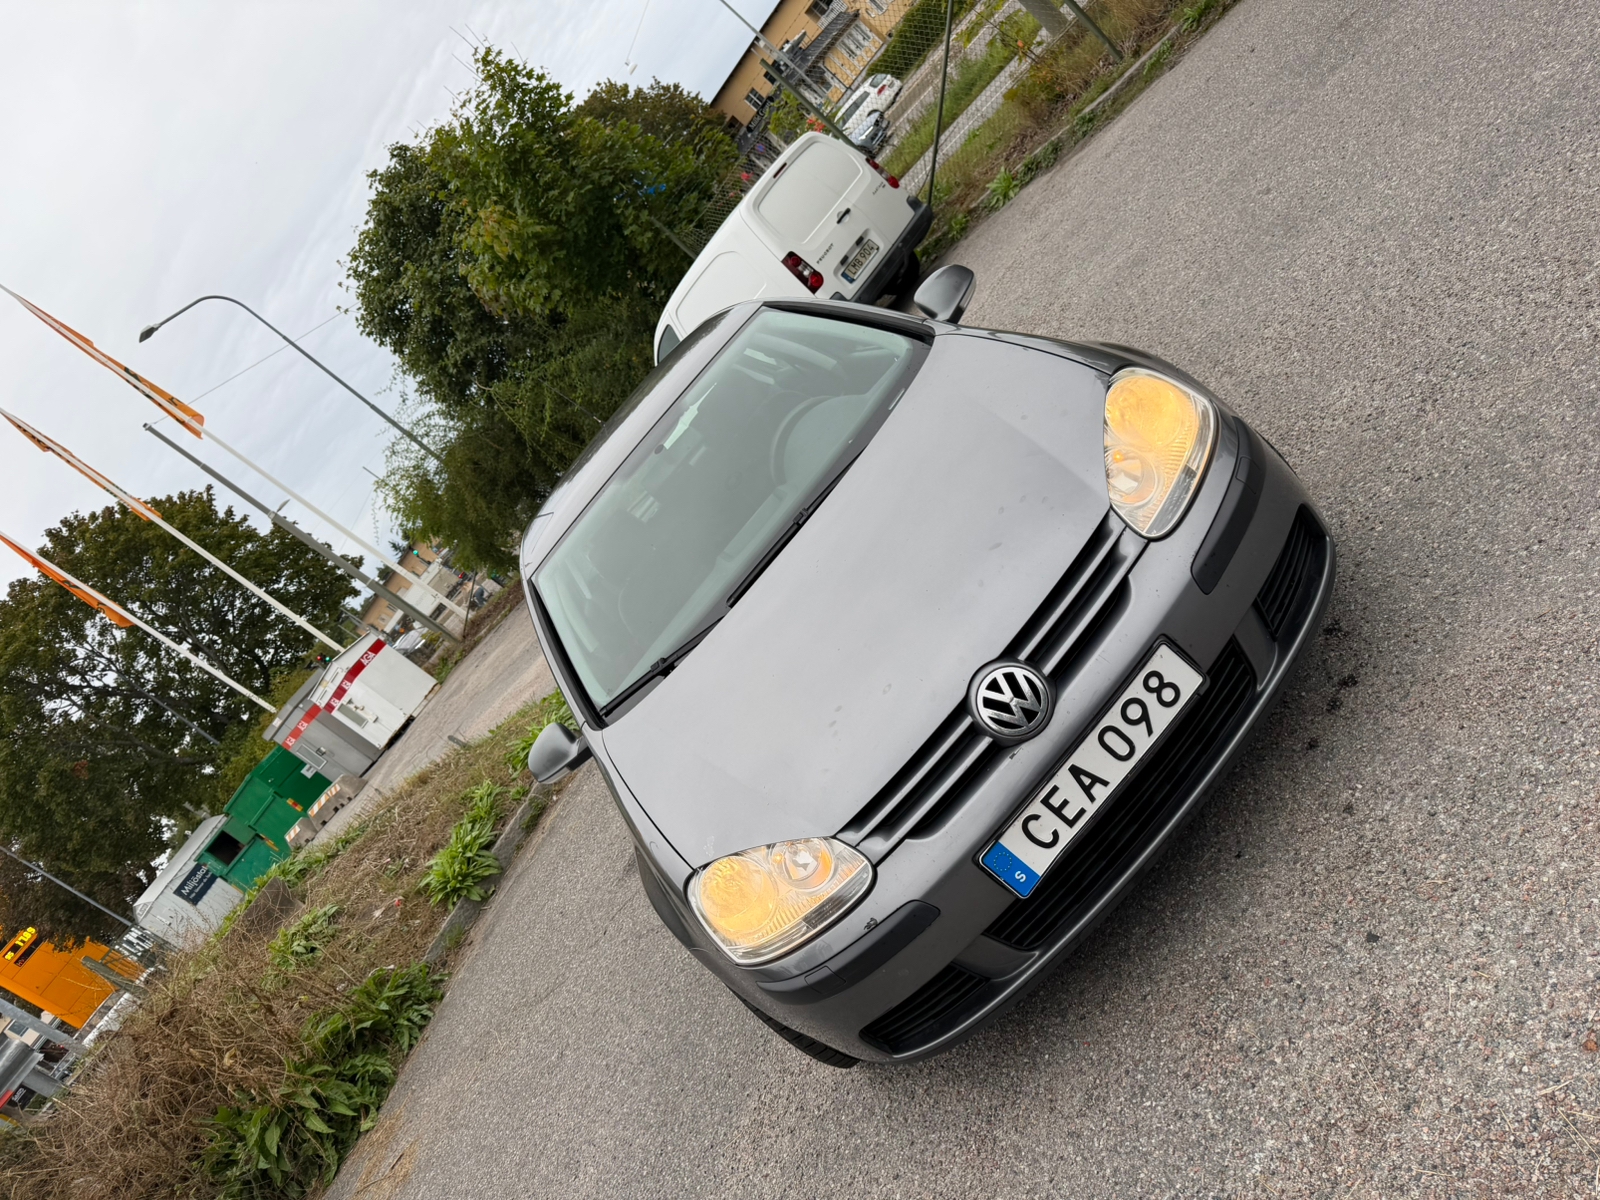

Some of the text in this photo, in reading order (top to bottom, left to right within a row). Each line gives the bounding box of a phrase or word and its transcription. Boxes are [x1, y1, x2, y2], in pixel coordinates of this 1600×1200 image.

[847, 244, 875, 275] LMB 904
[359, 650, 376, 666] AGA
[1021, 670, 1181, 849] CEA 098
[1014, 869, 1028, 883] S
